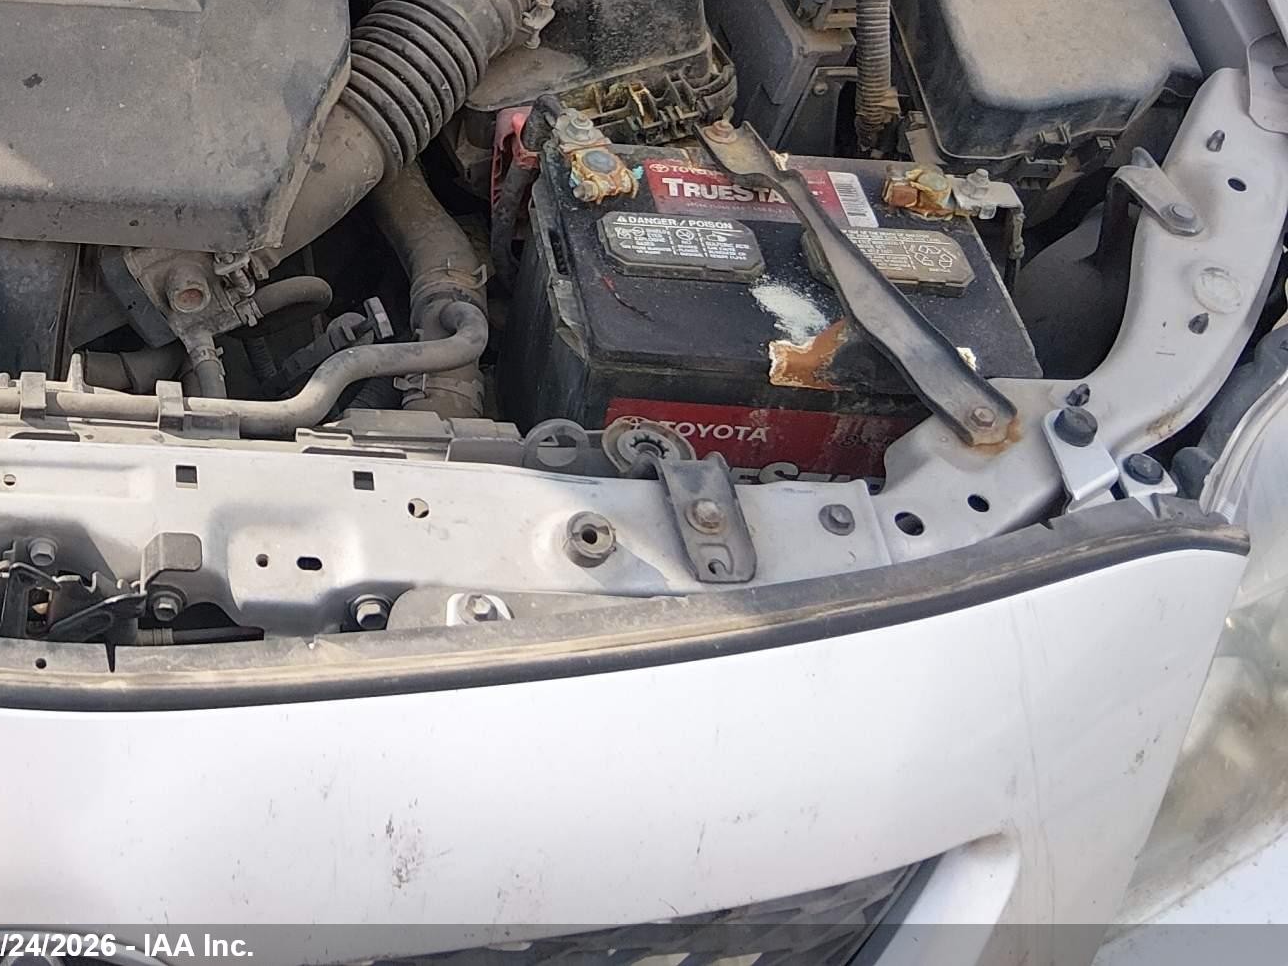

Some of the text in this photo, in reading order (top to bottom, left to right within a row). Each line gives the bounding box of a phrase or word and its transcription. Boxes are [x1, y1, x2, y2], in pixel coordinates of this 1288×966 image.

[662, 177, 788, 203] TRUESTA
[628, 216, 677, 227] DANGER
[688, 220, 733, 230] POISON
